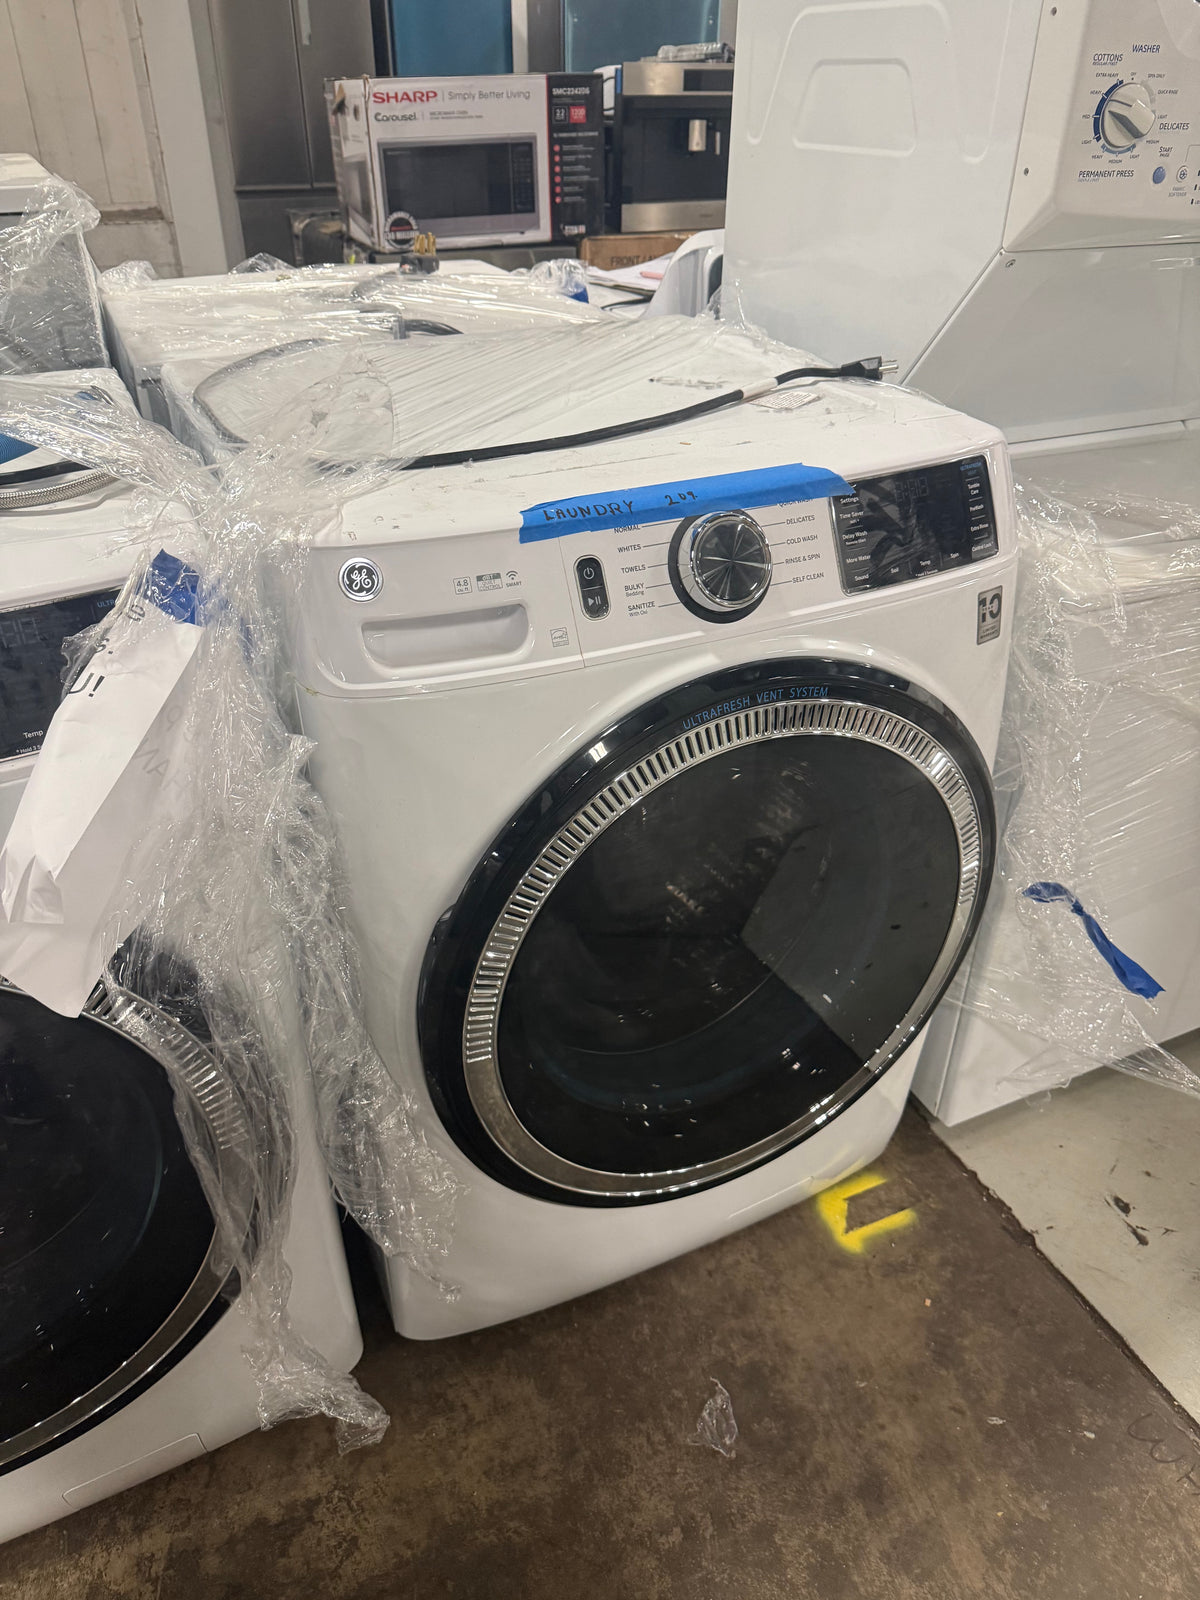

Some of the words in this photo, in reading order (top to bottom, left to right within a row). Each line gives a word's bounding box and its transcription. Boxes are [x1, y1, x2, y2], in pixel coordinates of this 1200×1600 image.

[1132, 44, 1161, 53] WASHER
[1092, 53, 1124, 62] COTTONS
[372, 90, 438, 104] SHARP
[448, 91, 476, 101] Simply
[478, 90, 504, 100] Better
[506, 89, 531, 100] Living
[373, 112, 418, 122] Carousel
[1159, 122, 1190, 131] DELICATES
[1078, 170, 1115, 178] PERMANENT
[1116, 169, 1135, 178] PRESS
[839, 496, 860, 504] Settings
[542, 499, 634, 522] LAUNDRY
[786, 514, 815, 525] DELICATES
[613, 524, 641, 534] NORMAL
[786, 537, 802, 545] COLD
[802, 534, 818, 542] WASH
[617, 543, 641, 553] WHITES
[785, 556, 802, 565] RINSE
[807, 552, 821, 561] SPIN
[620, 564, 646, 574] TOWELS
[456, 579, 469, 587] 4.8
[791, 575, 806, 584] SELF
[806, 572, 825, 581] CLEAN
[505, 580, 522, 588] SMART
[624, 582, 645, 592] BULKY
[627, 600, 655, 612] SANITIZE
[682, 695, 751, 730] ULTRAFRESH
[756, 688, 784, 704] VENT
[789, 686, 829, 699] SYSTEM
[23, 729, 44, 740] Temp
